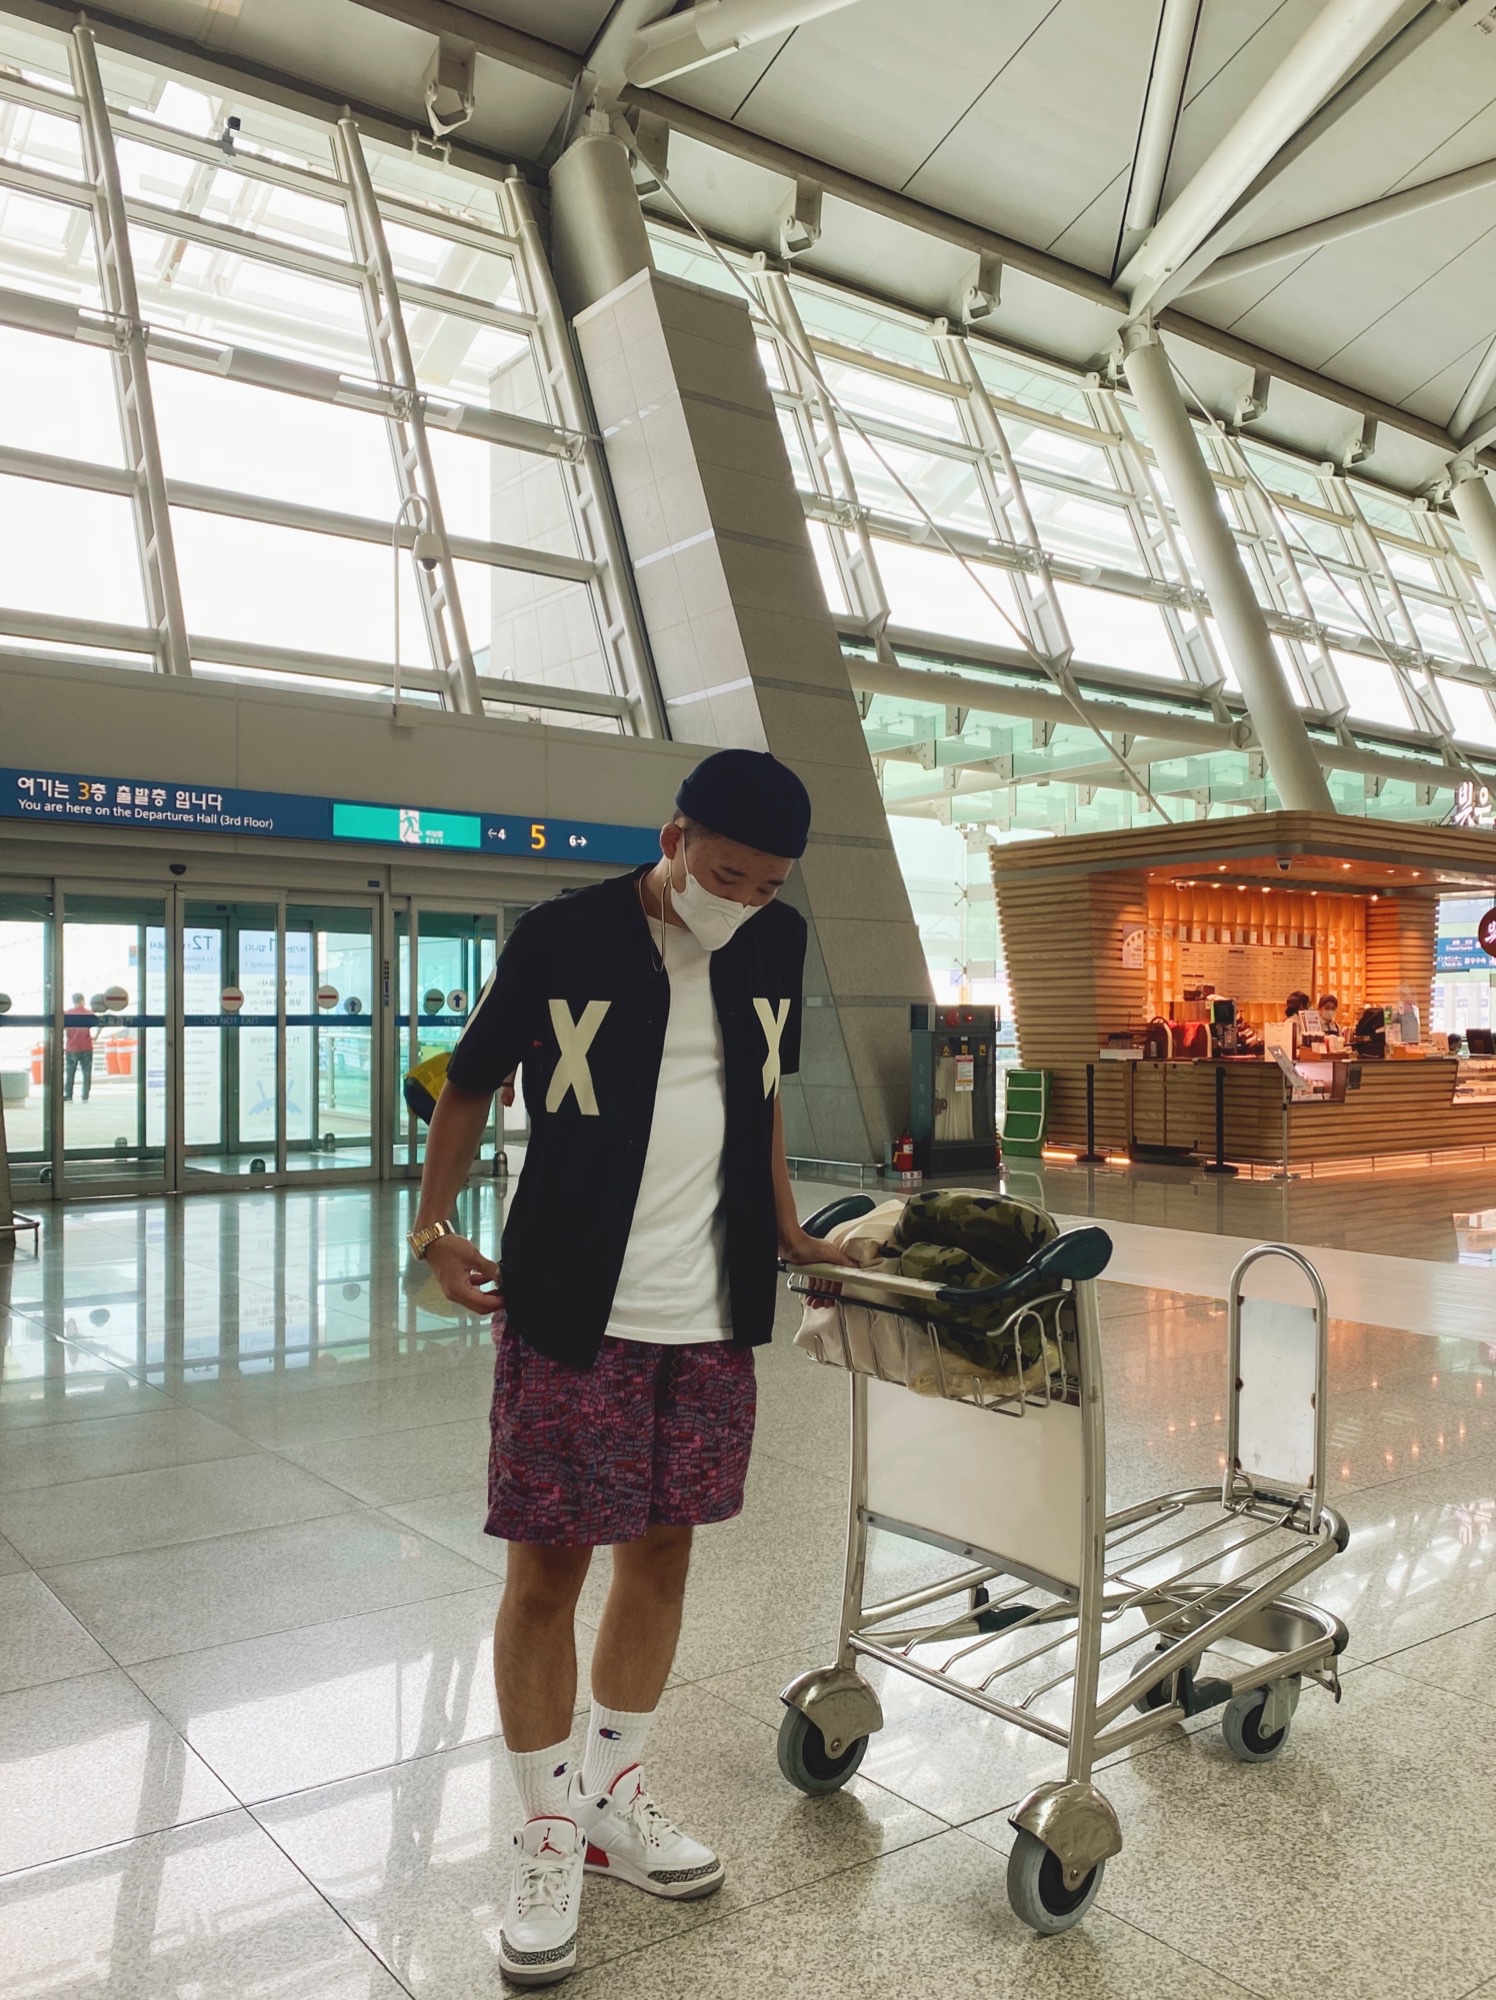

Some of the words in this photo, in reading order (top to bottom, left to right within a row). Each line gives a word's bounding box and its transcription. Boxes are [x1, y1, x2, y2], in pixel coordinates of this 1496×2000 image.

[17, 776, 70, 800] 여기는
[78, 781, 107, 802] 3층
[116, 785, 167, 808] 출발층
[175, 789, 223, 811] 입니다
[18, 799, 41, 812] You
[44, 803, 63, 813] are
[66, 801, 92, 816] here
[95, 807, 110, 817] on
[113, 805, 132, 819] the
[135, 807, 194, 823] Departures
[196, 812, 218, 825] Hall
[220, 813, 242, 828] (3rd
[244, 816, 274, 830] Floor)
[498, 828, 507, 841] 4
[530, 824, 547, 849] 5
[568, 834, 578, 847] 6
[203, 1016, 218, 1025] DO
[220, 1016, 238, 1025] NOT
[240, 1016, 259, 1025] EXIT
